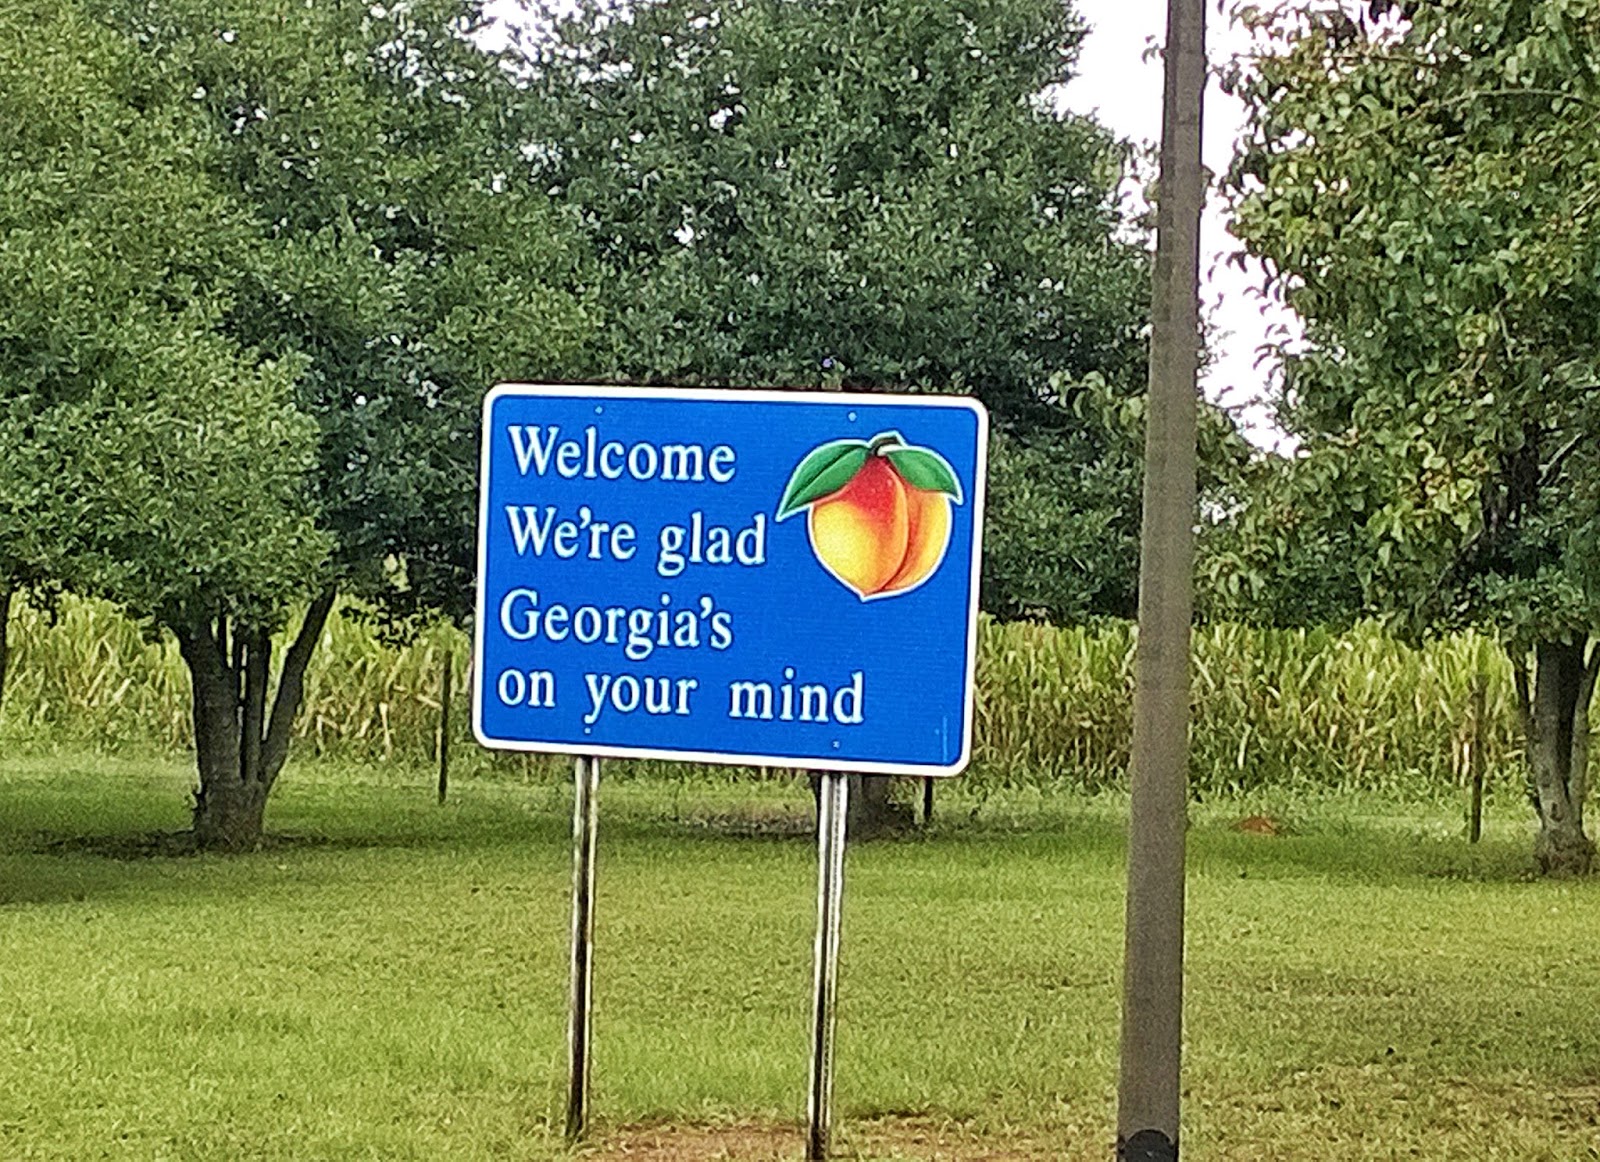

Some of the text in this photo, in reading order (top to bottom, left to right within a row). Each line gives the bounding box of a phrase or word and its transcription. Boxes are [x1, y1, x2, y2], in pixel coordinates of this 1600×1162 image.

[508, 425, 735, 482] Welcome
[505, 506, 765, 576] We're glad
[500, 588, 732, 660] Georgia's
[498, 668, 864, 724] on your mind
